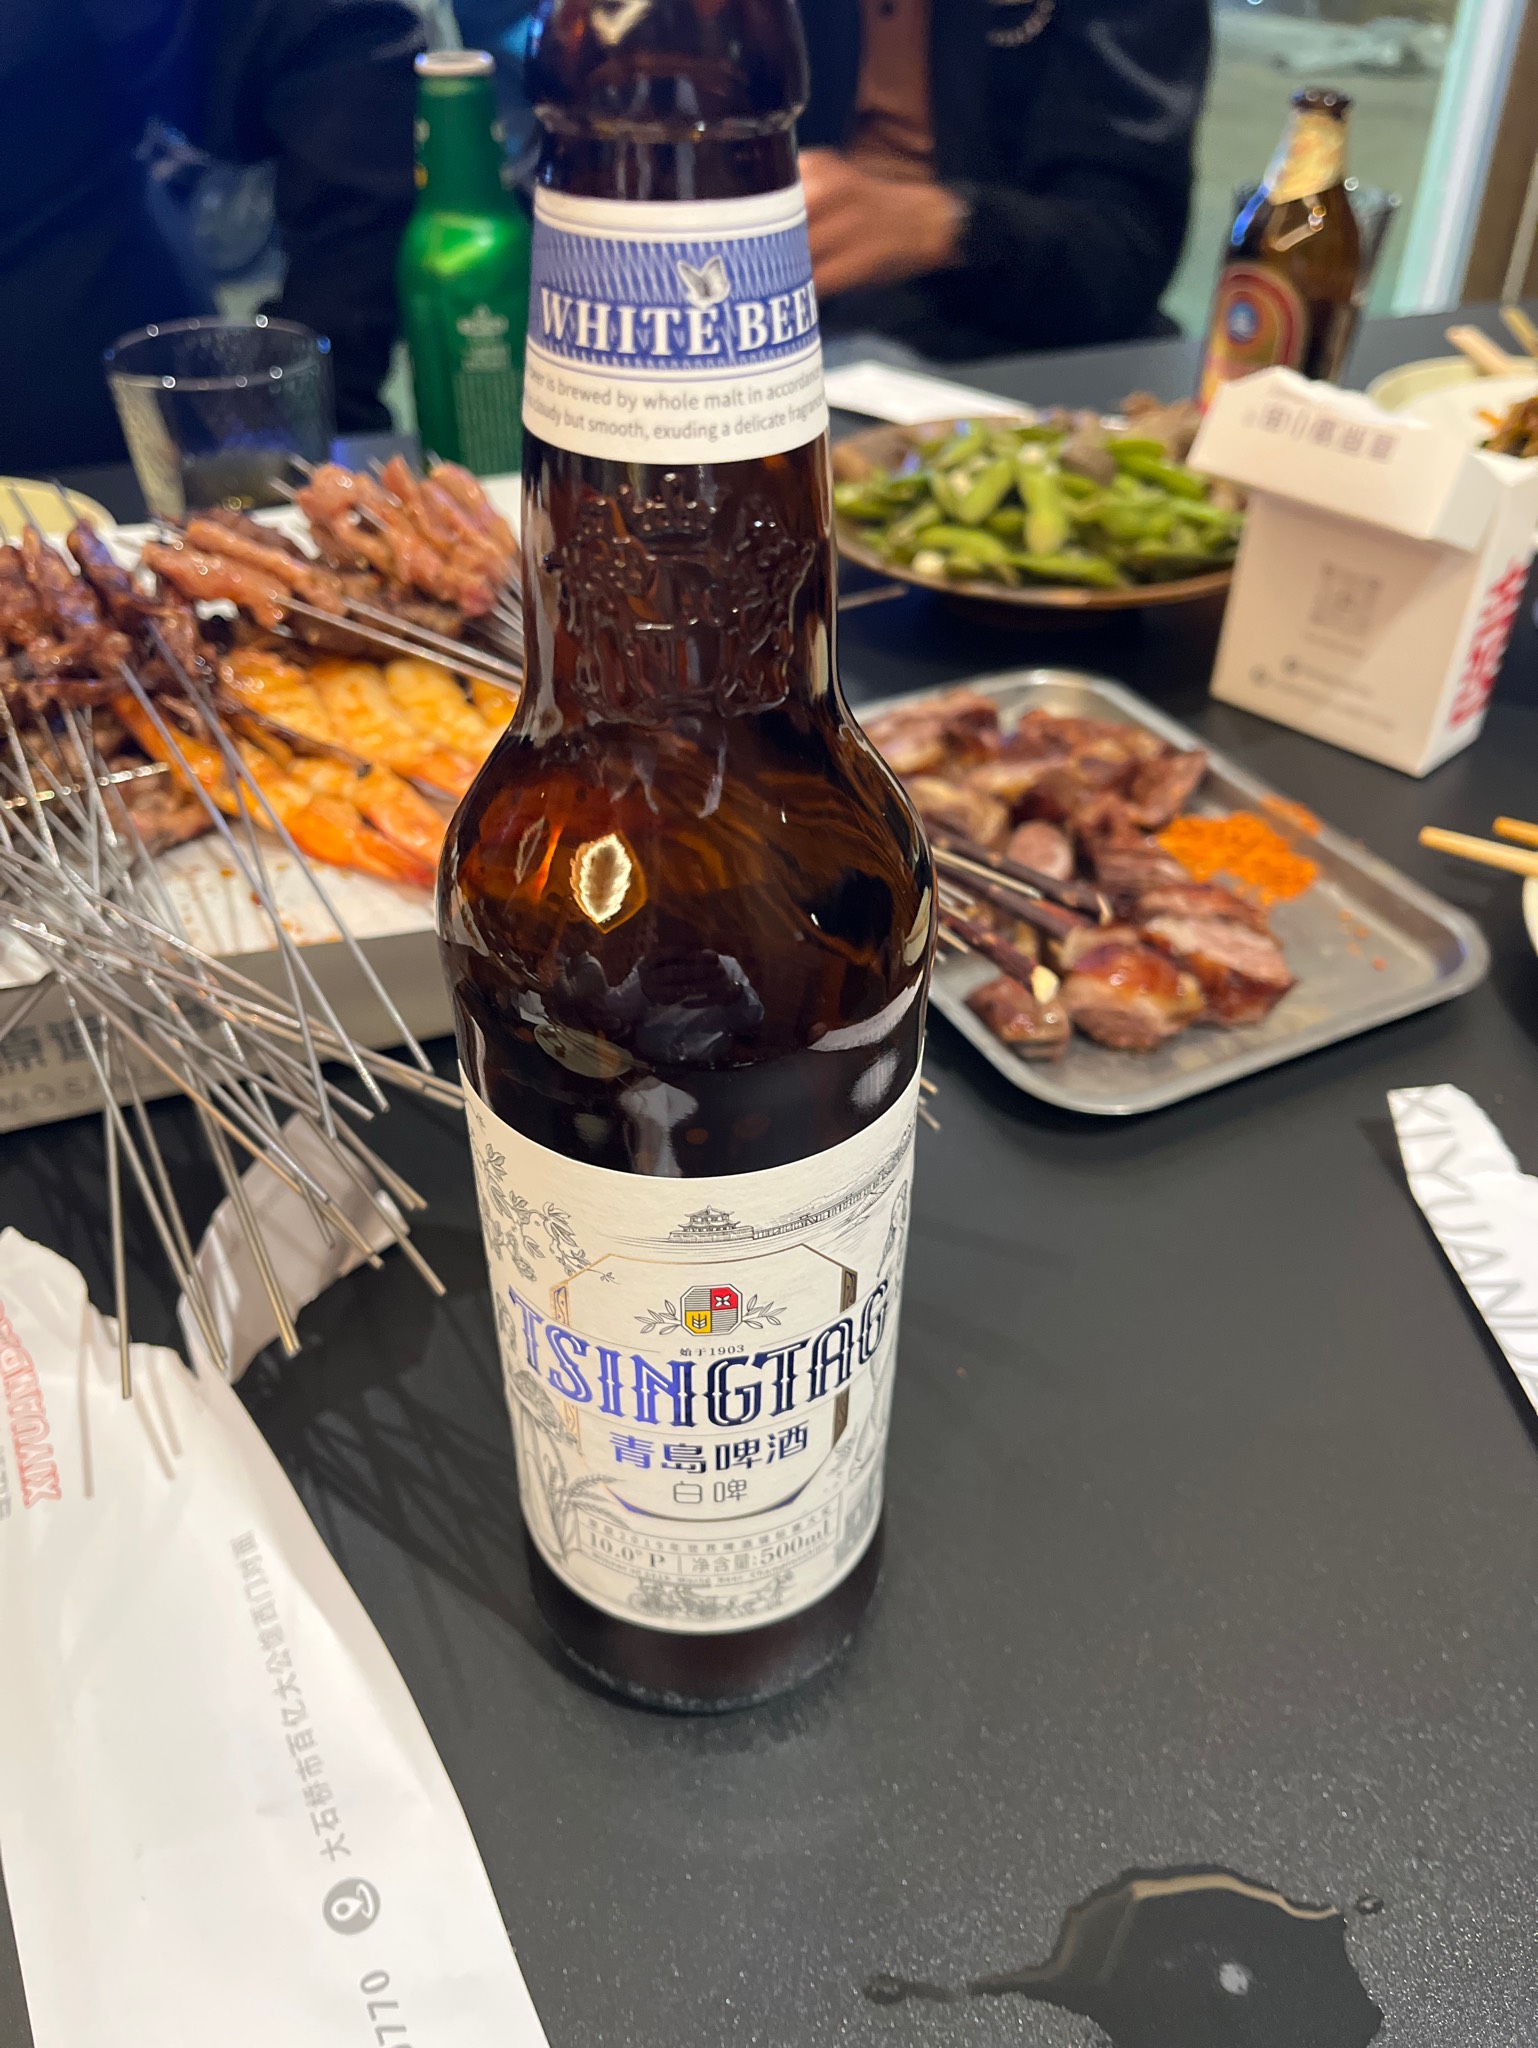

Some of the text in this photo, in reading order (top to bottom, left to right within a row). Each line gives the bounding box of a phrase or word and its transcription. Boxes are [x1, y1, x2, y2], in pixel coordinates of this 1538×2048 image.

[540, 286, 720, 356] WHITE
[558, 378, 611, 406] brewed
[617, 388, 638, 413] by
[643, 388, 700, 411] whole
[704, 386, 744, 410] malt
[749, 383, 763, 402] in
[563, 409, 585, 431] but
[588, 417, 650, 442] smooth,
[653, 413, 719, 443] exuding
[722, 424, 731, 438] a
[735, 412, 786, 435] delicate
[672, 1477, 747, 1504] 白啤
[360, 1969, 412, 2048] 770
